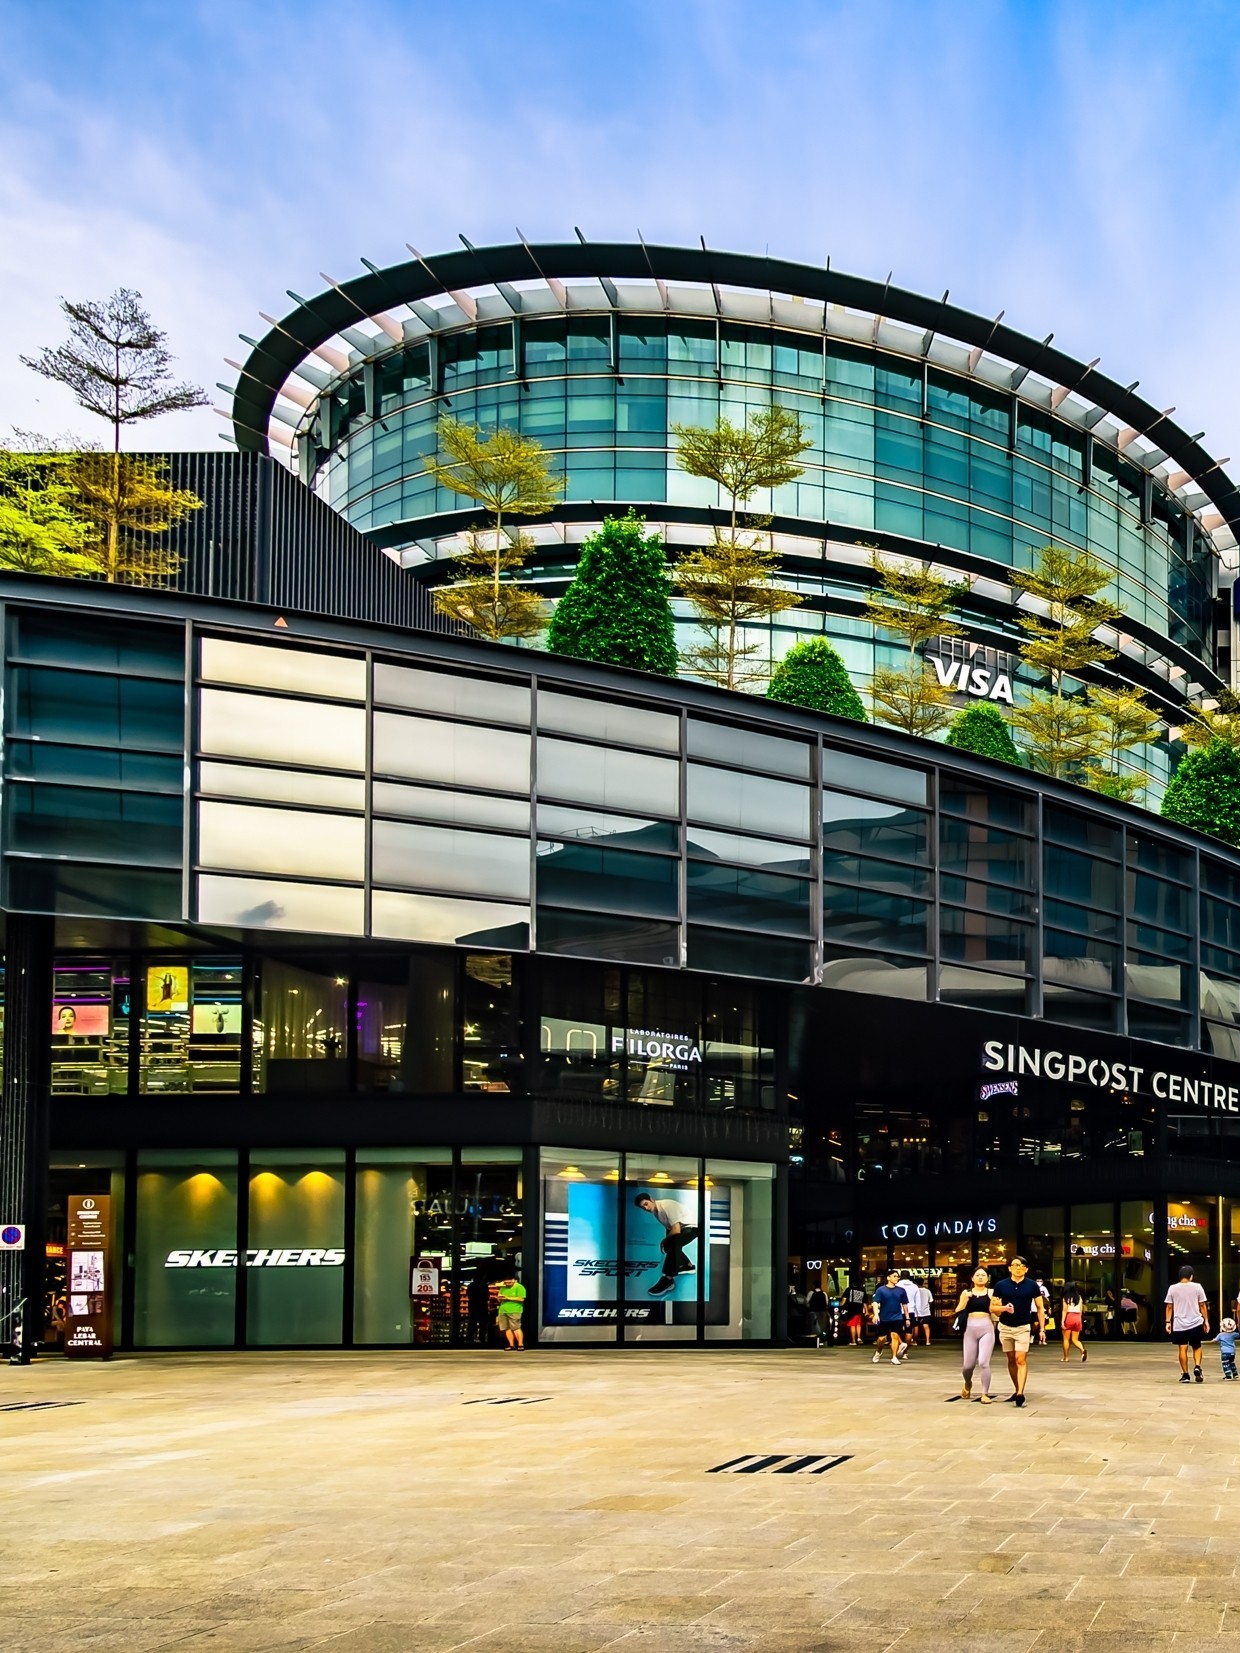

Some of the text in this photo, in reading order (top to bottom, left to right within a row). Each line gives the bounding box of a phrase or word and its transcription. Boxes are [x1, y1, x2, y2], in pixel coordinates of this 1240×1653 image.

[925, 654, 1014, 704] VISA
[630, 1028, 689, 1041] LABORATOIRES
[612, 1036, 702, 1063] FILORGA
[669, 1063, 689, 1071] PARIS
[984, 1040, 1239, 1112] SINGPOST CENTRE
[1178, 1212, 1197, 1227] cha
[572, 1259, 661, 1269] SKECERS
[558, 1308, 650, 1318] SKECHRS
